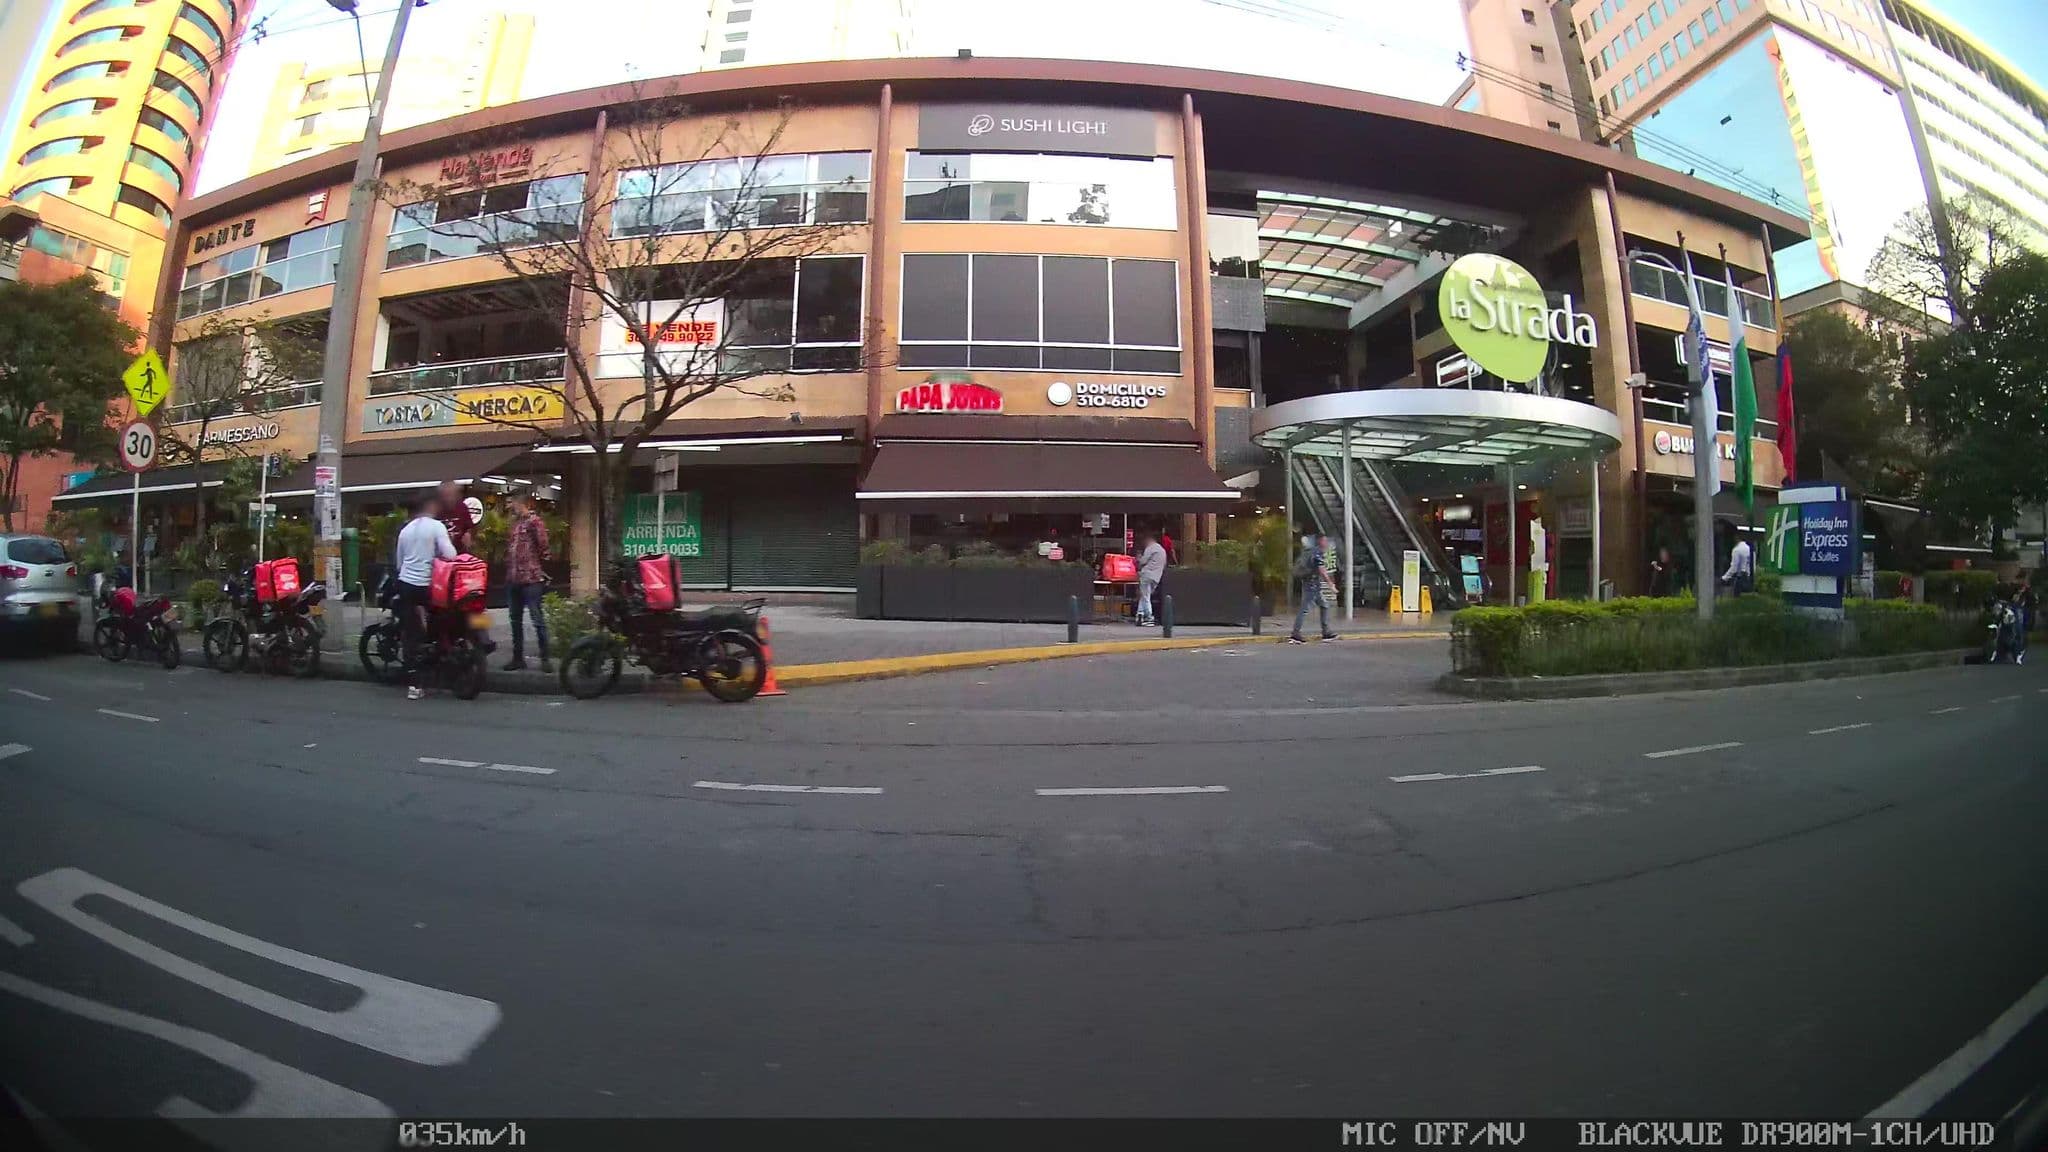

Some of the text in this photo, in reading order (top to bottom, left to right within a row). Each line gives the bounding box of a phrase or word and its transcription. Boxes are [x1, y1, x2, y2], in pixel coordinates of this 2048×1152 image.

[1000, 118, 1107, 135] SUSHI LIGHT
[194, 219, 256, 254] DANTE
[1449, 277, 1599, 348] la Strada
[900, 383, 943, 410] PAPA
[1076, 382, 1167, 397] DOMICILIOS
[470, 396, 547, 417] MERCAO
[1077, 395, 1149, 409] 310-6810
[127, 431, 152, 458] 30
[626, 525, 697, 539] ARRIENDA
[1803, 516, 1848, 531] Holiday Inn
[1804, 531, 1848, 551] Express
[1817, 551, 1840, 562] Suites
